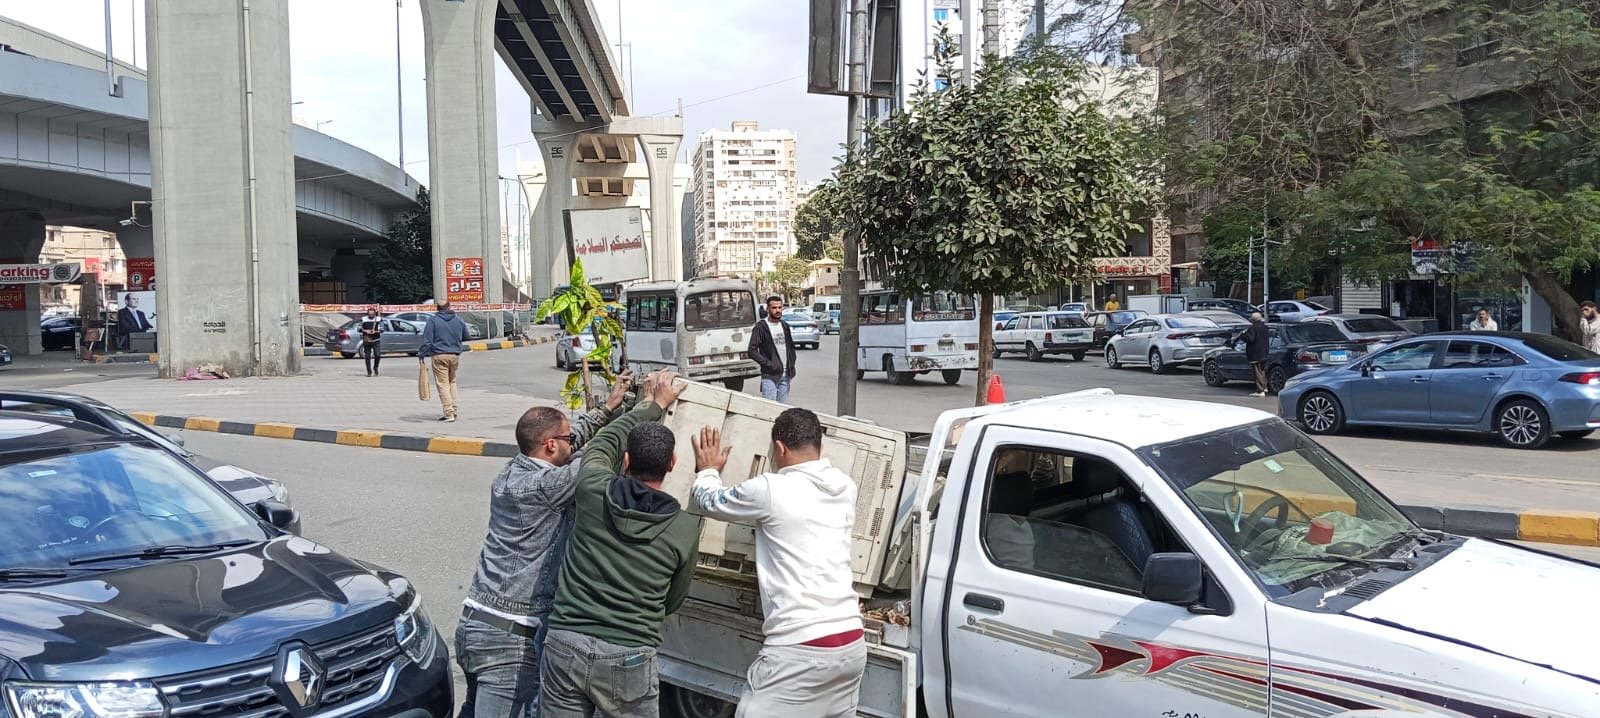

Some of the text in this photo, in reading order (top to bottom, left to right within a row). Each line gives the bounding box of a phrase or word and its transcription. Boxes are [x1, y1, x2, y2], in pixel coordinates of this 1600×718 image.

[575, 236, 608, 255] السلامة
[0, 266, 50, 280] arking
[455, 263, 461, 271] P
[450, 279, 481, 292] جراج
